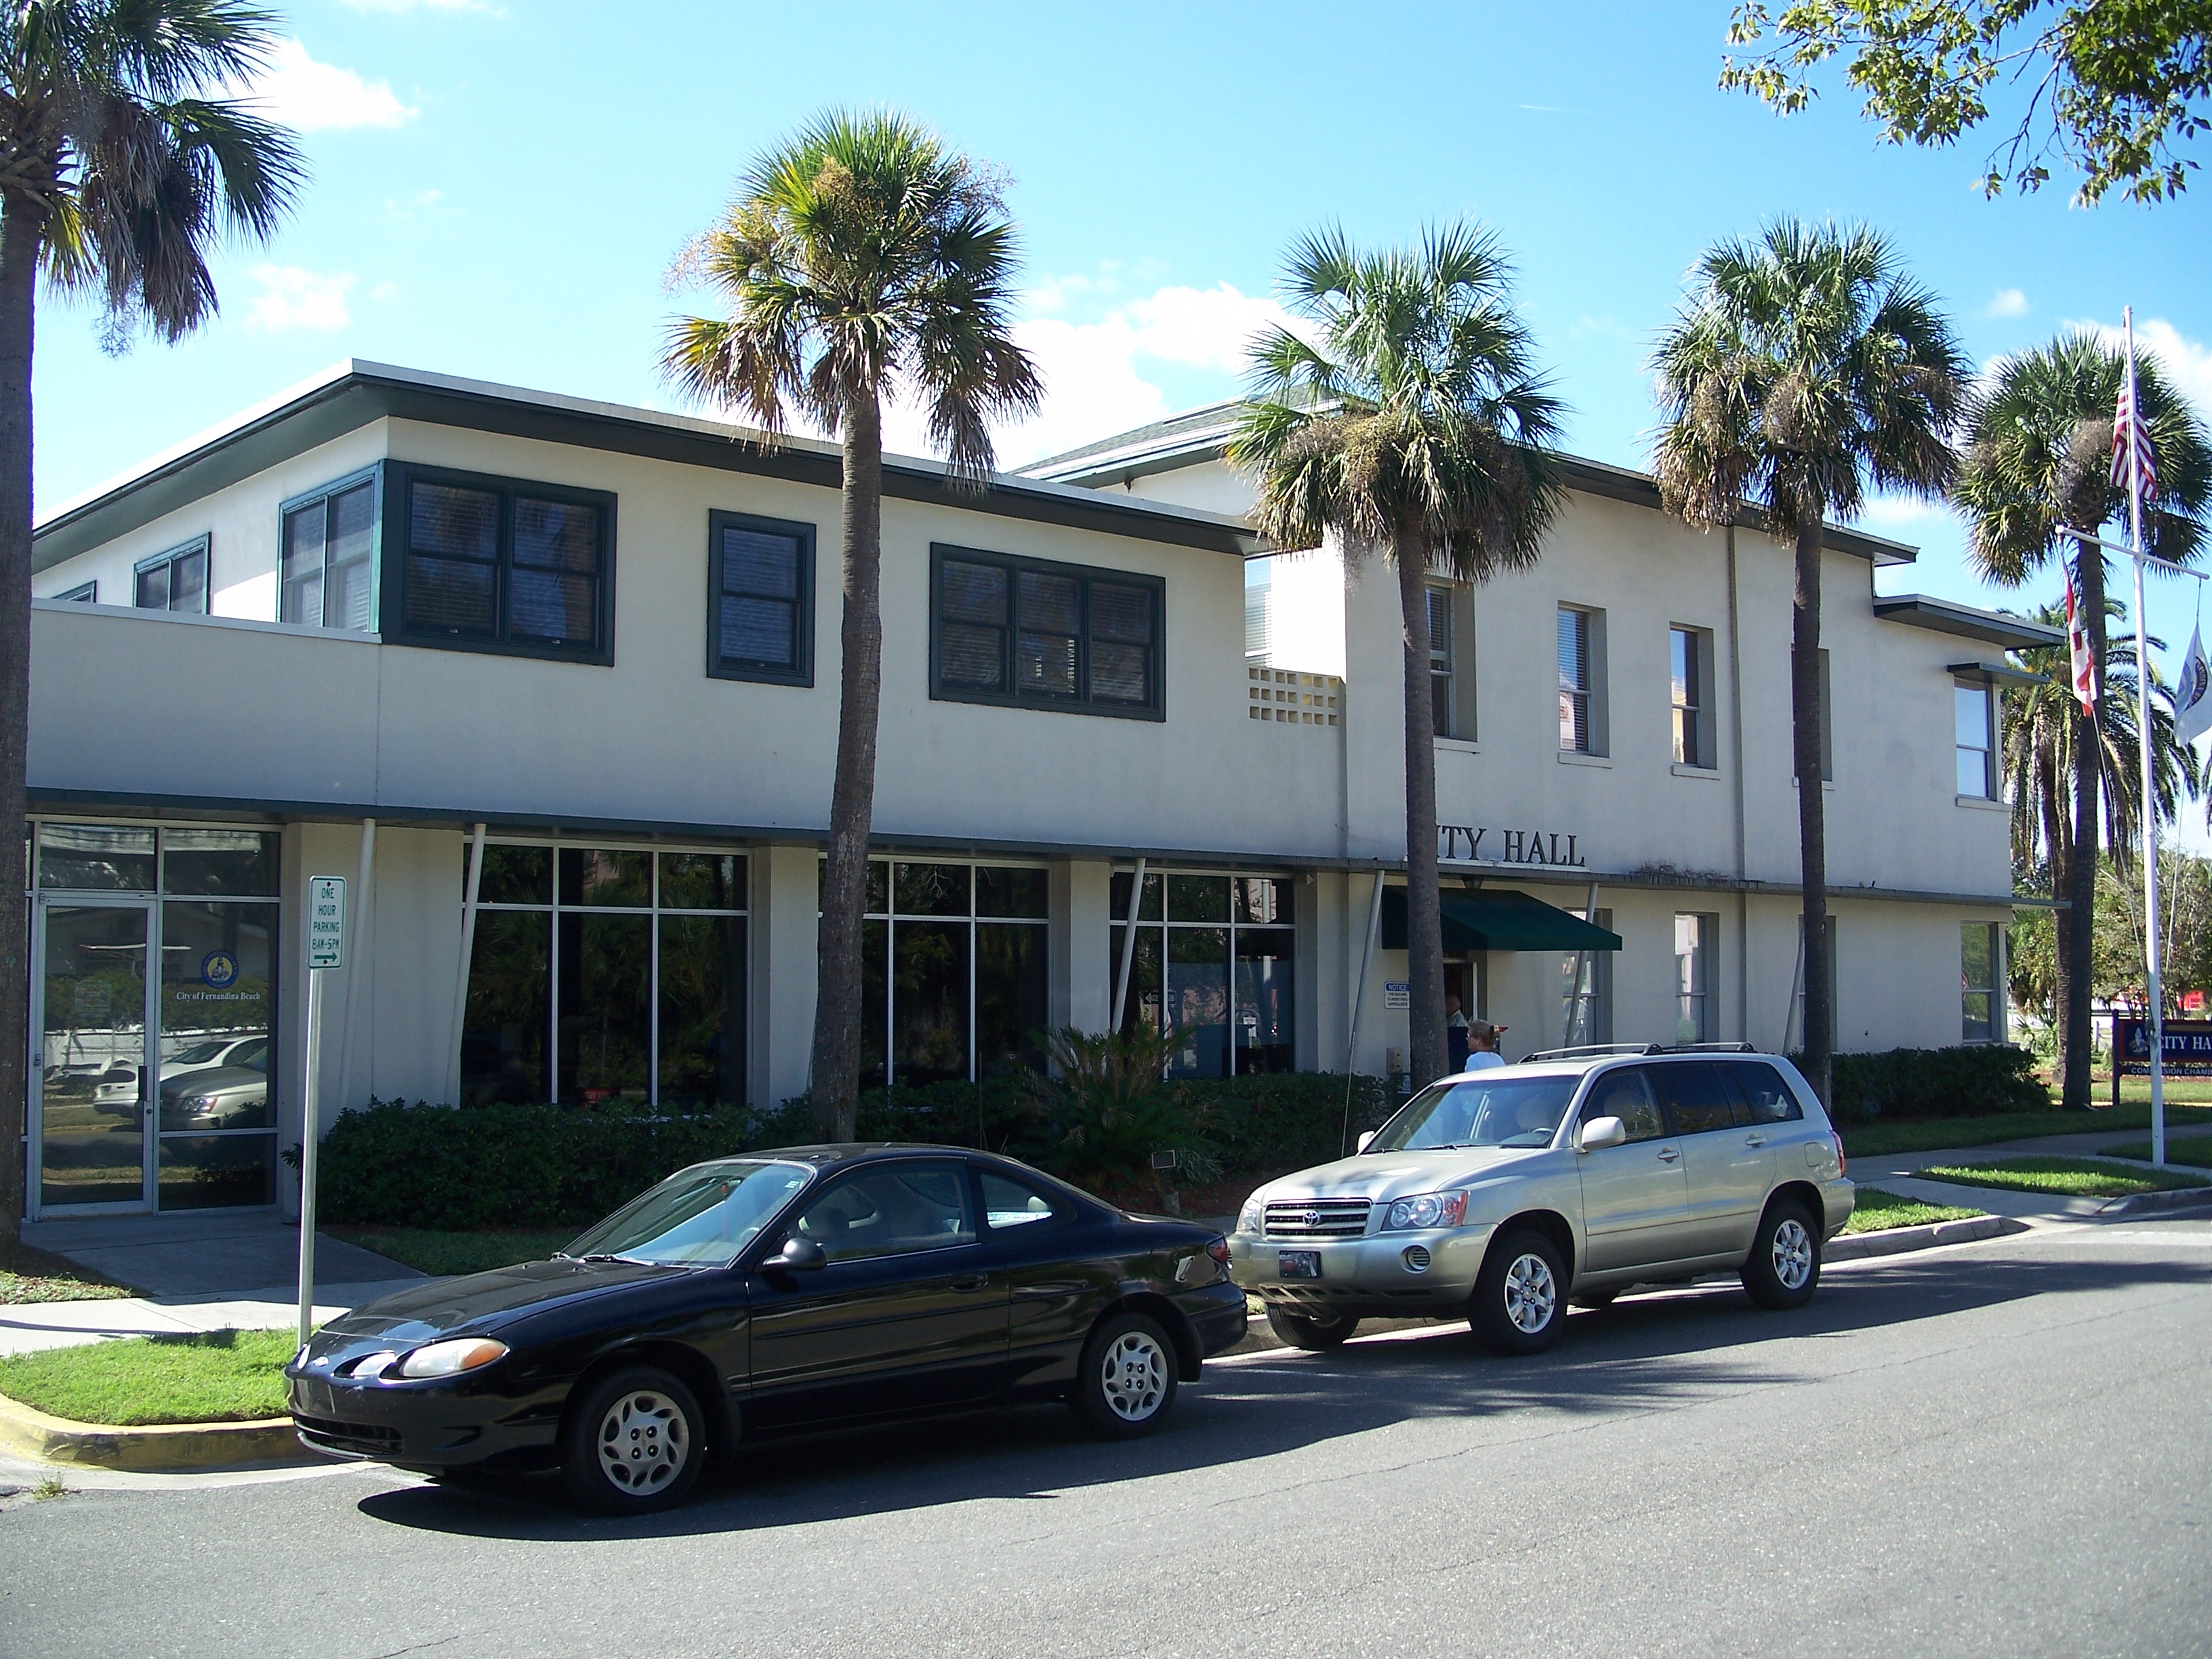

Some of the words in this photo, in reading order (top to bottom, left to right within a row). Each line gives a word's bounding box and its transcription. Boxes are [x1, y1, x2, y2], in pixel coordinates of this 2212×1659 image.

[1437, 825, 1487, 861] TY
[1502, 830, 1586, 867] HALL
[321, 887, 335, 899] ONE
[318, 905, 336, 916] HOUR
[313, 921, 340, 933] PARKING
[312, 938, 340, 950] 8AM-5PM
[176, 991, 190, 1002] City
[192, 991, 201, 1000] of
[201, 992, 239, 1000] Fernandina
[241, 992, 260, 1000] Beach
[2192, 1036, 2212, 1050] HA
